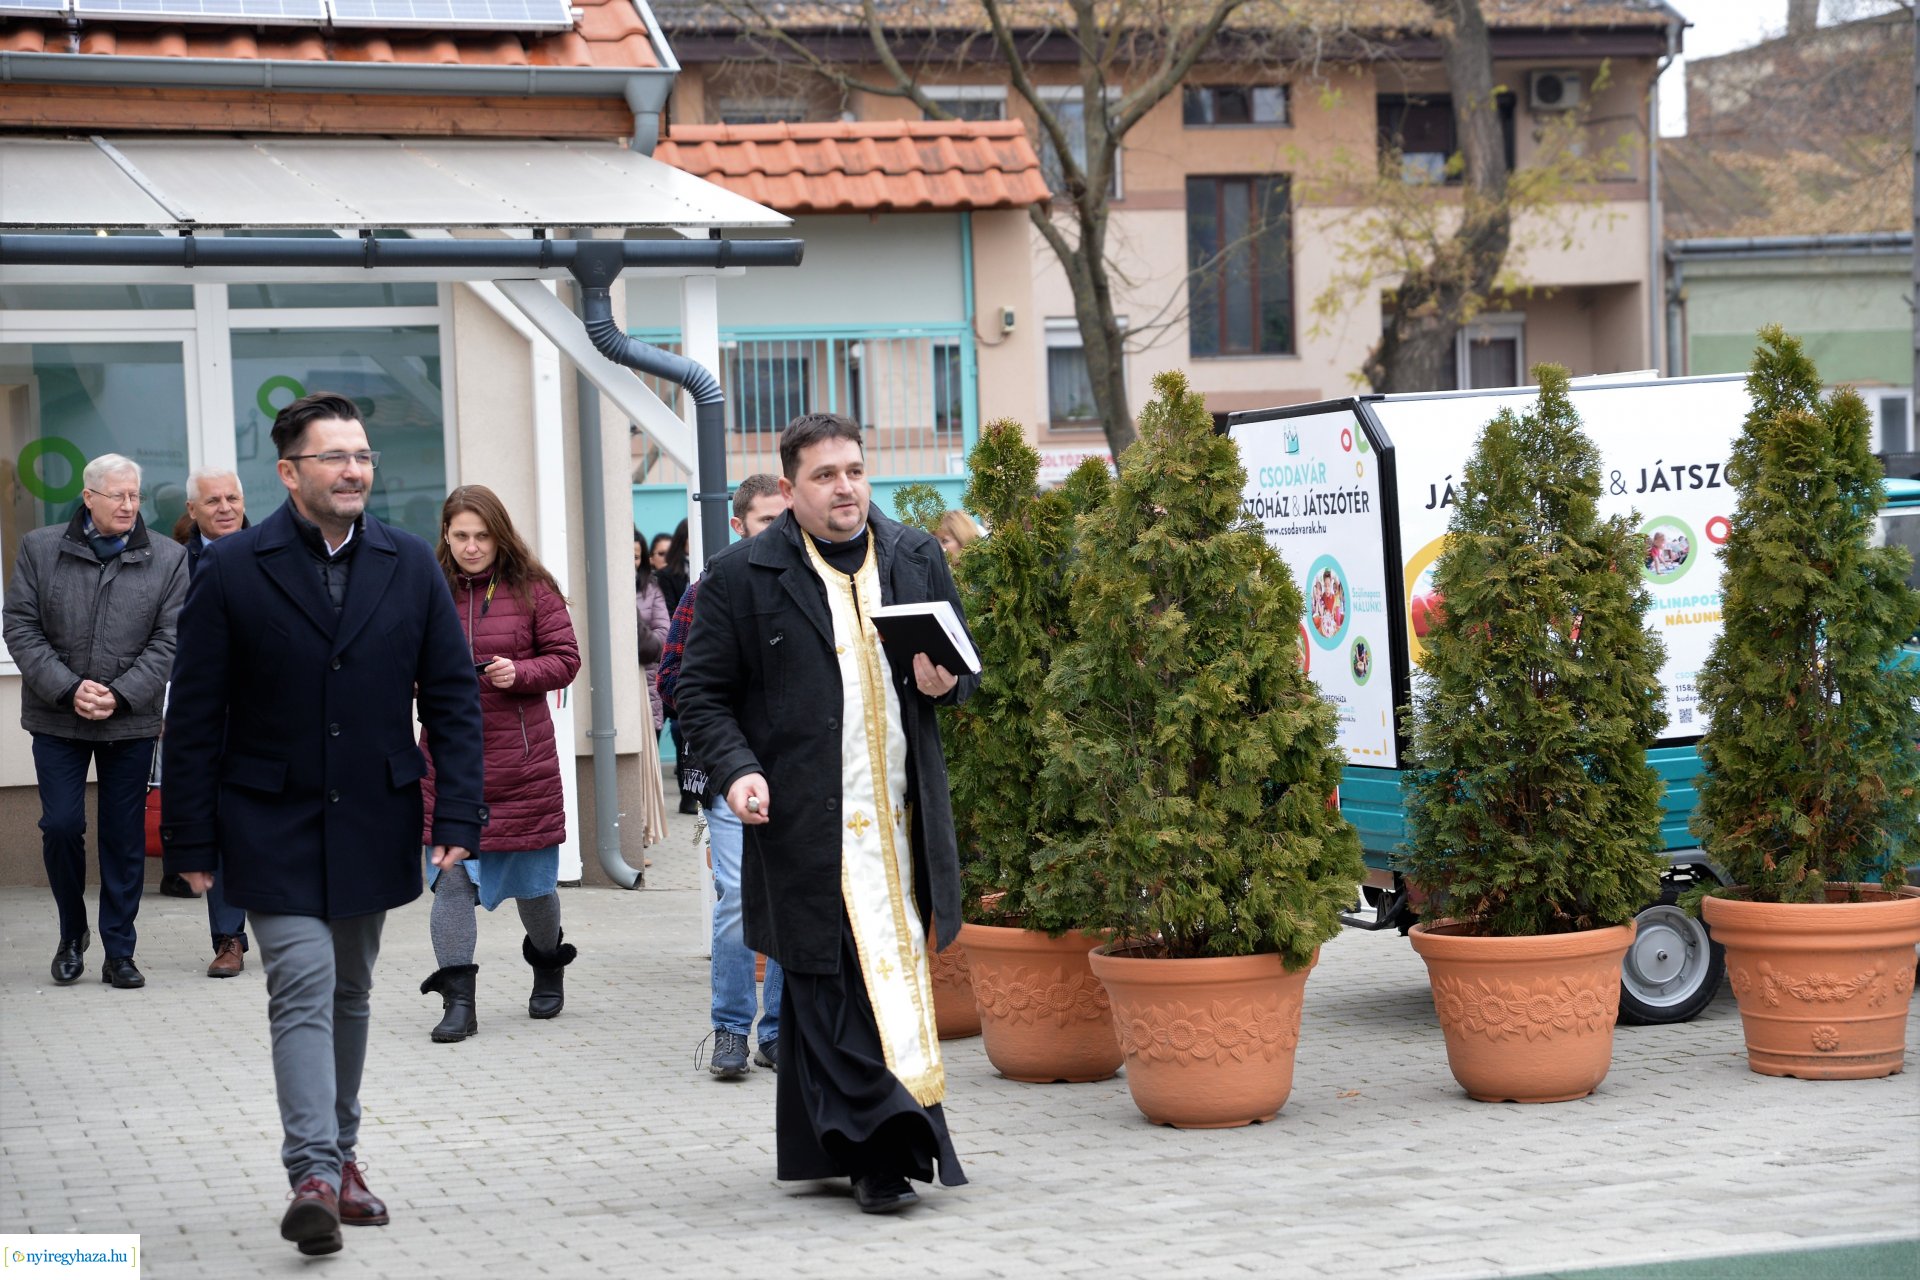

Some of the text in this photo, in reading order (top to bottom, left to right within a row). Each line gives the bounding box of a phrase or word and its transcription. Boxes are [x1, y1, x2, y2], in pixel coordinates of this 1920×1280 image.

[1259, 457, 1327, 489] CSODAVÁR
[1610, 469, 1628, 496] &
[1242, 484, 1370, 519] SZÓHÁZ & JÁTSZÓTÉR
